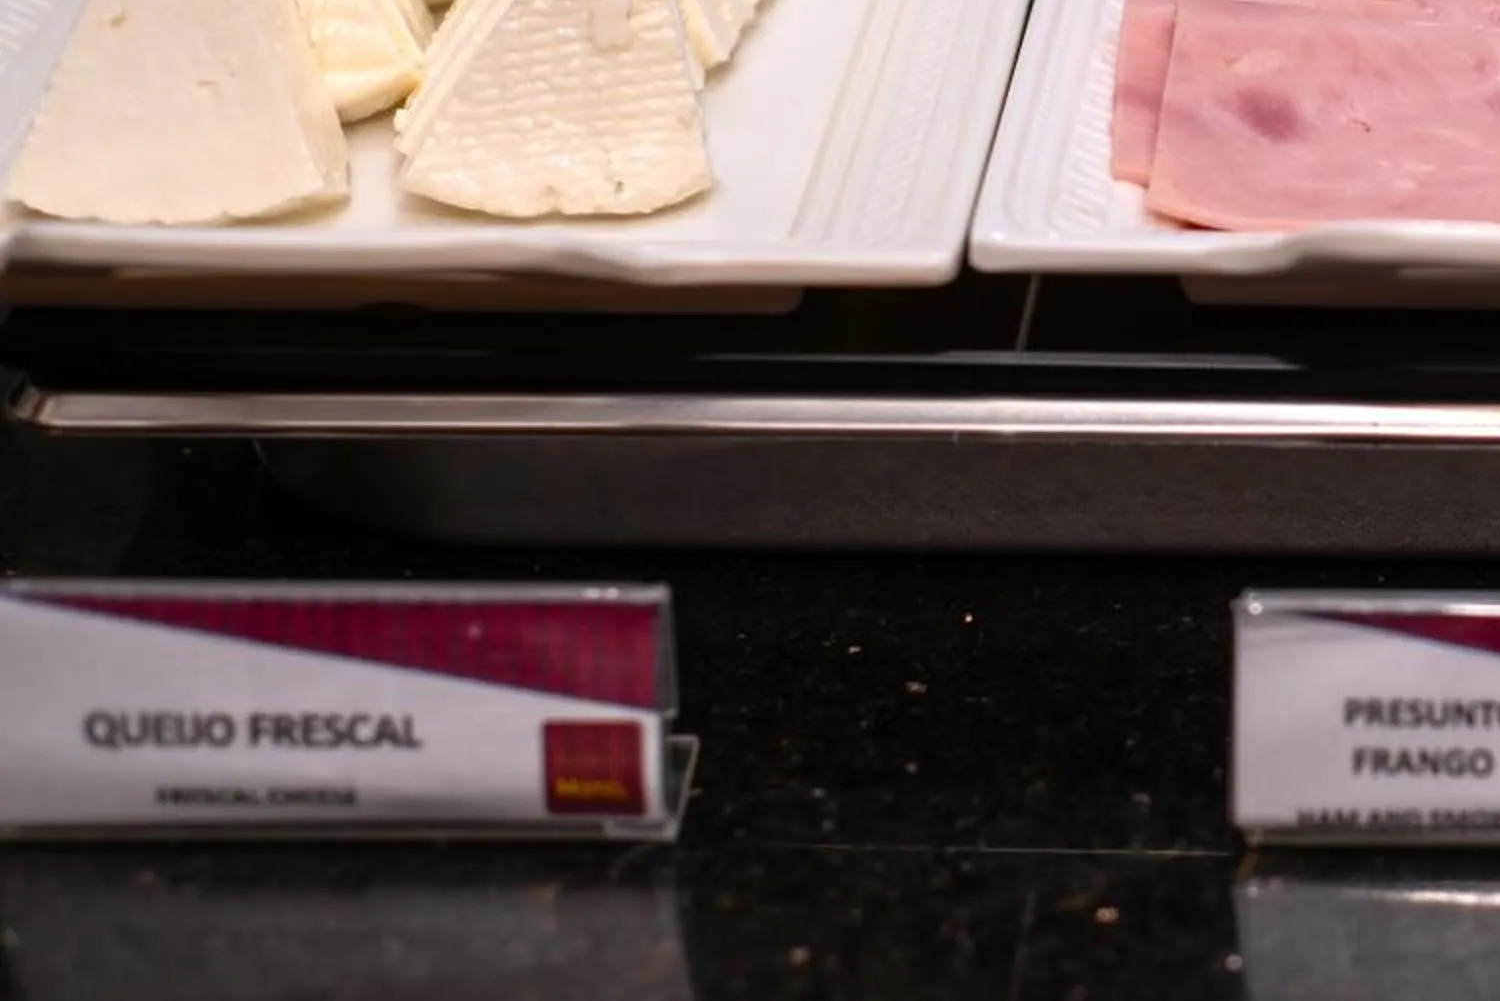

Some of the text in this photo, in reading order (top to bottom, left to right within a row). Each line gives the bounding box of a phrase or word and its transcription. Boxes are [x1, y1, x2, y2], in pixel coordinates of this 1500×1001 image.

[82, 710, 424, 751] QUEIJO FRESCAL
[1351, 746, 1496, 779] FRANGO
